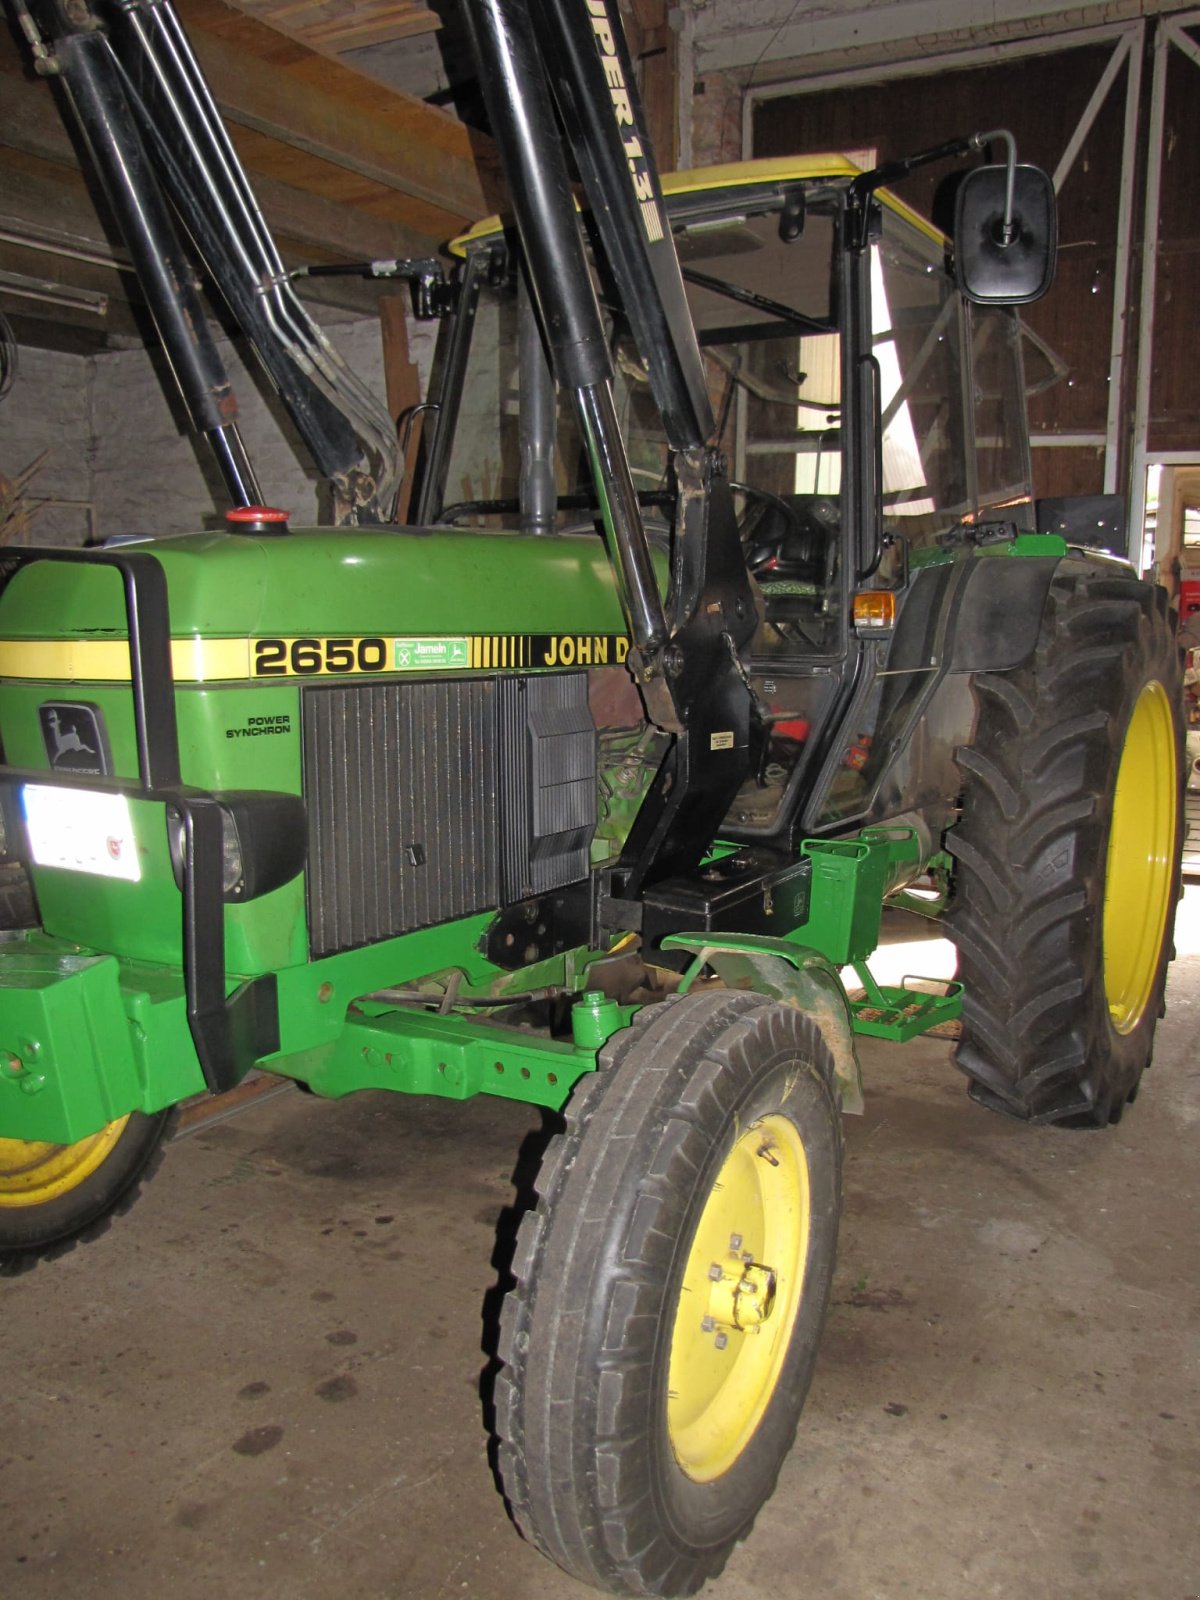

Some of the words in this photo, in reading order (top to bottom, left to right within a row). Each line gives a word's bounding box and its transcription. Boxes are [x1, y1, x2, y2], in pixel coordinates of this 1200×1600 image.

[624, 136, 654, 201] 1.3
[255, 638, 387, 675] 2650
[544, 636, 608, 665] JOHN
[226, 725, 291, 738] SYNCHRON
[248, 715, 290, 726] POWER
